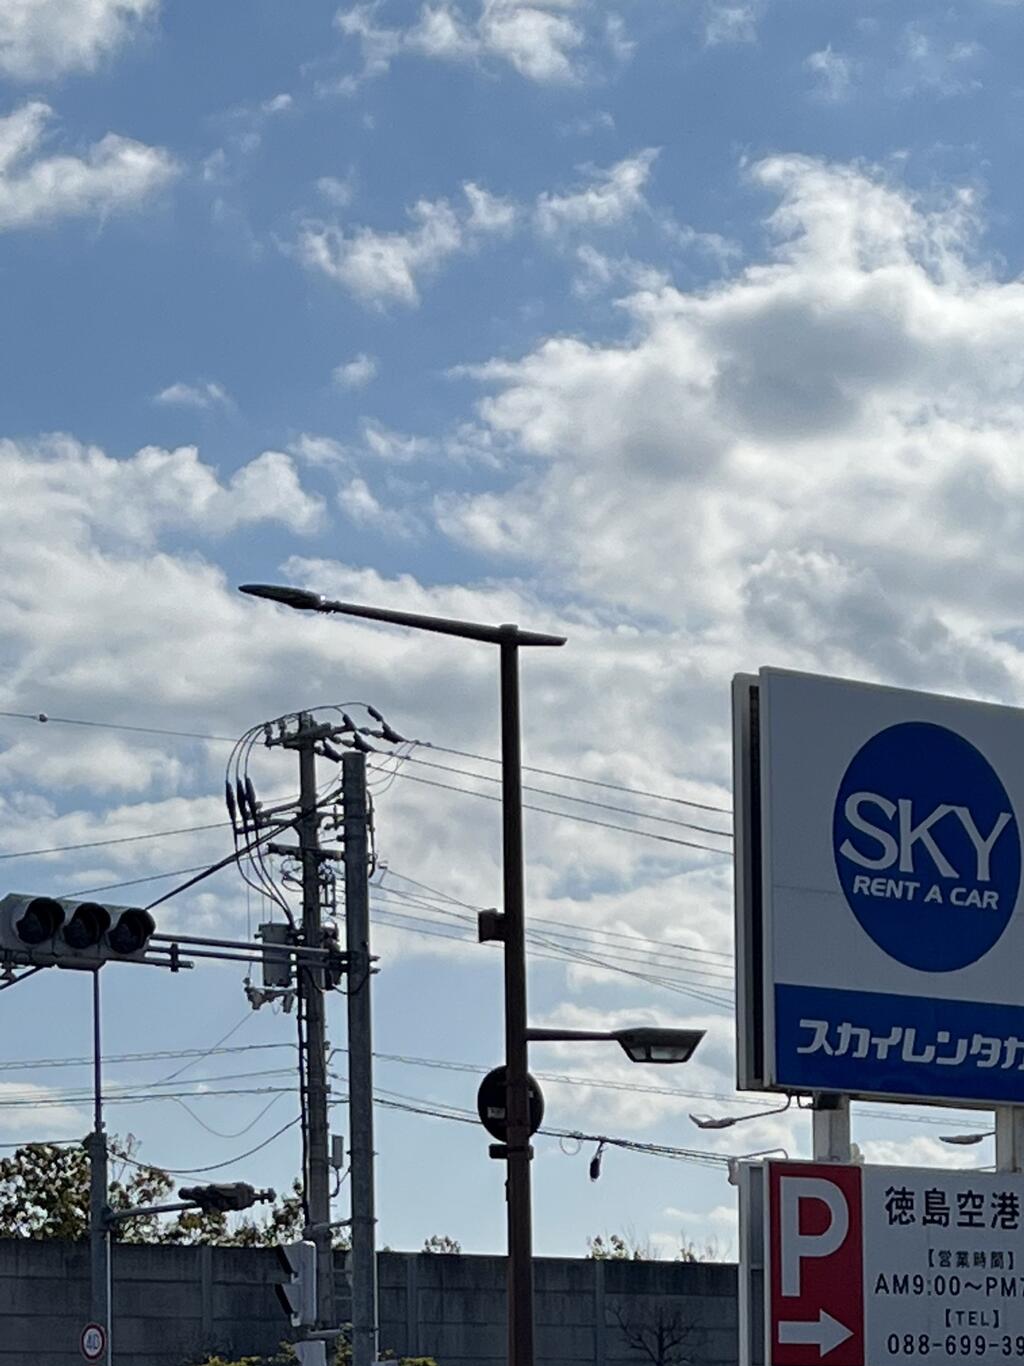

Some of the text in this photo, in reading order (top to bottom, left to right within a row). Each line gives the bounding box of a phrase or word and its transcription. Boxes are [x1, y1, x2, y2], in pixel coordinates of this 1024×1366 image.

[840, 792, 1012, 881] SKY
[853, 876, 999, 909] RENT A CAR
[781, 1176, 849, 1297] P
